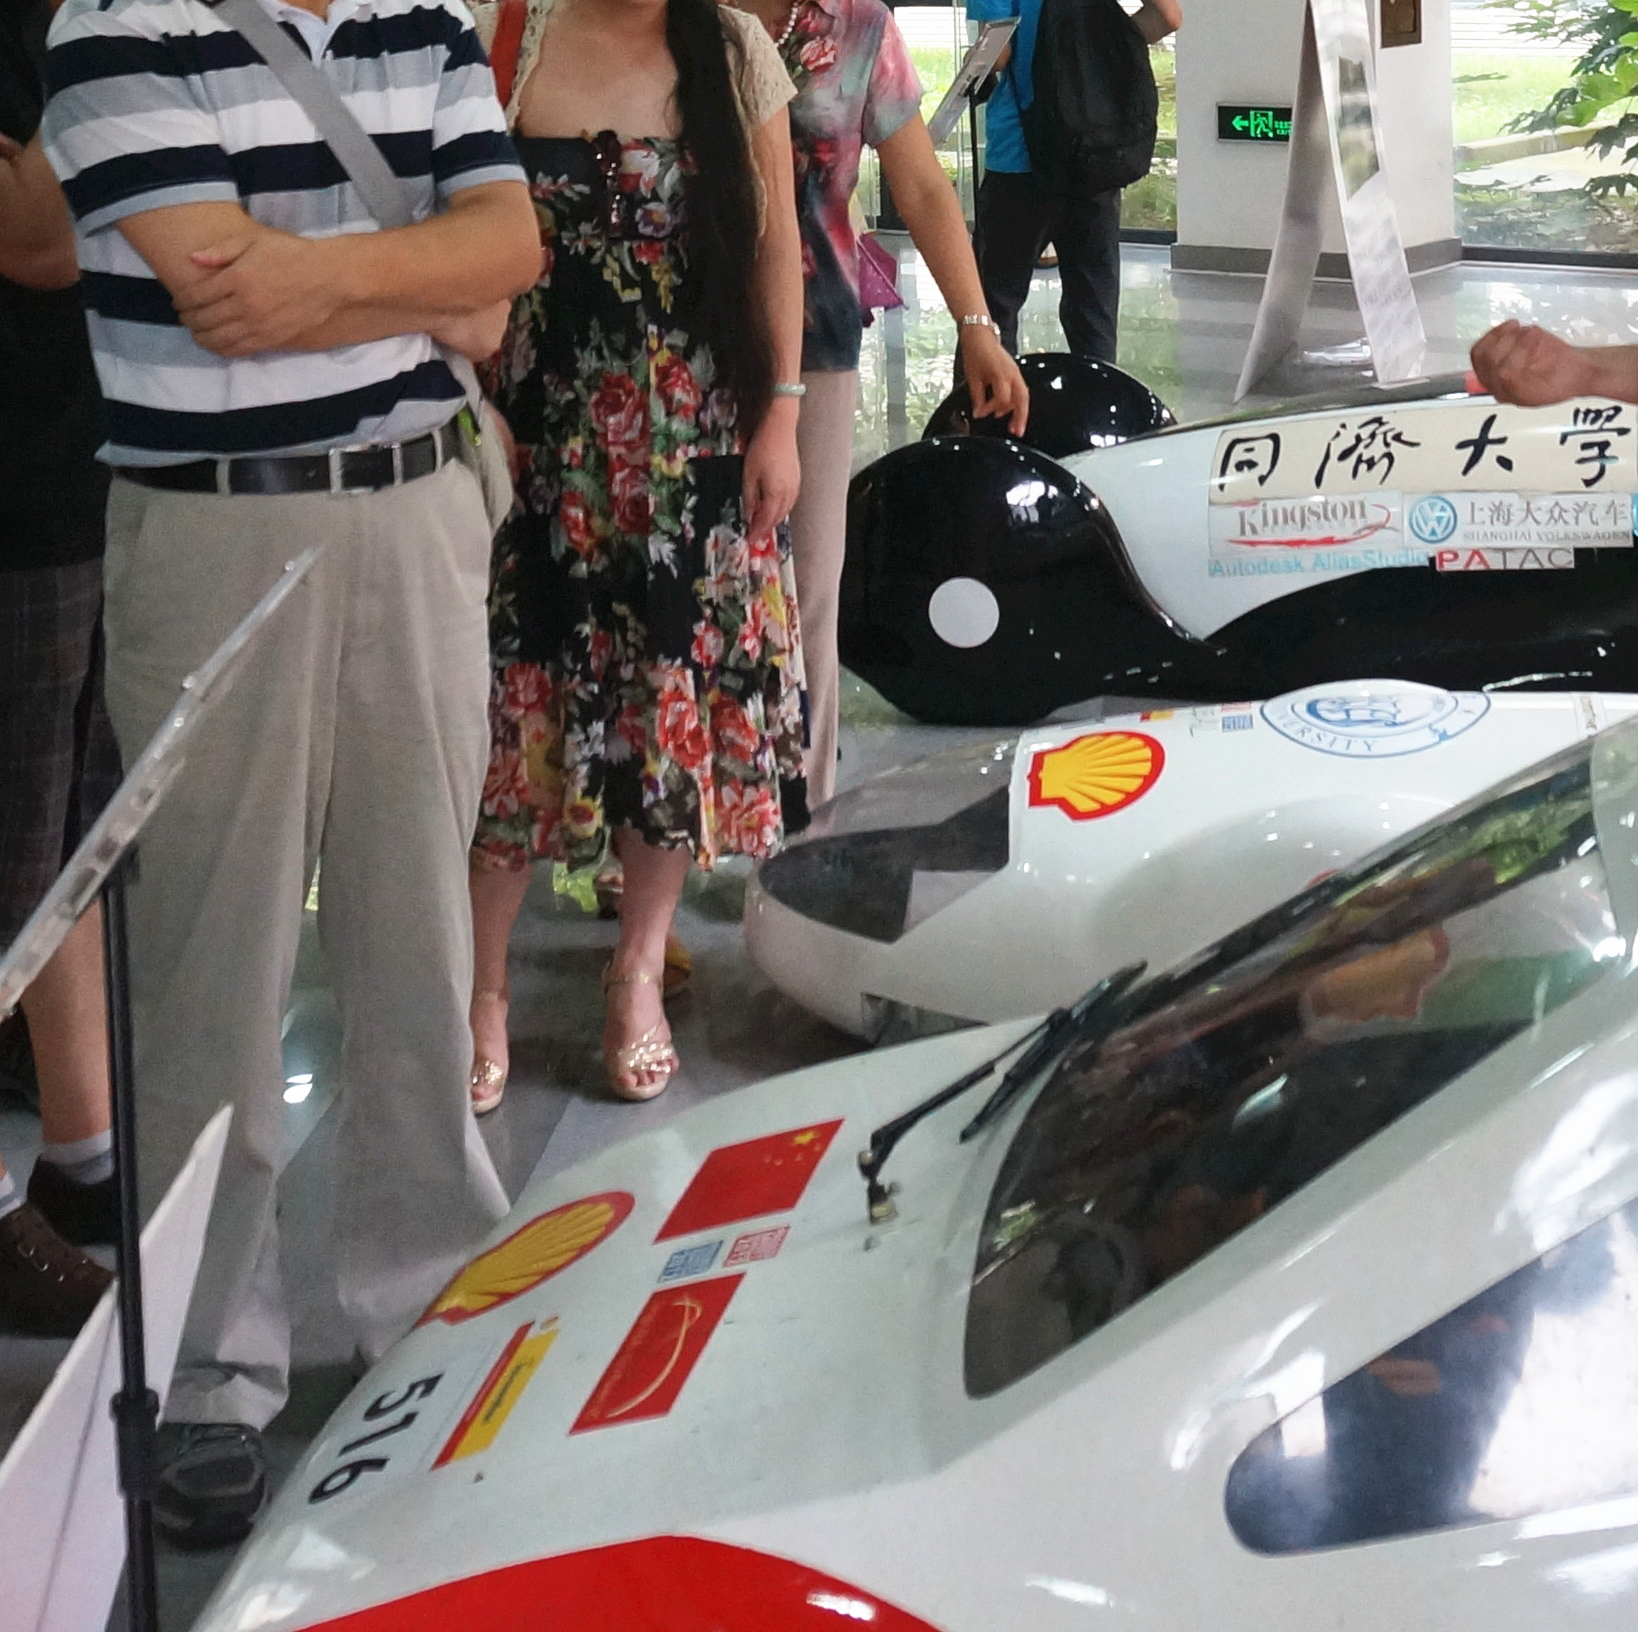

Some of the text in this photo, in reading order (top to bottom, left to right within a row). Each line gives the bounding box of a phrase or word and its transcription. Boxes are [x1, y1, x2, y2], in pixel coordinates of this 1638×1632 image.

[1238, 498, 1367, 537] Kingston
[1463, 499, 1629, 528] 上海大众汽车
[1464, 528, 1631, 542] SHANGHAI VOLKSWAGEN
[1210, 554, 1304, 577] Autodesk
[1436, 547, 1573, 571] PATAC
[308, 1372, 445, 1505] 516
